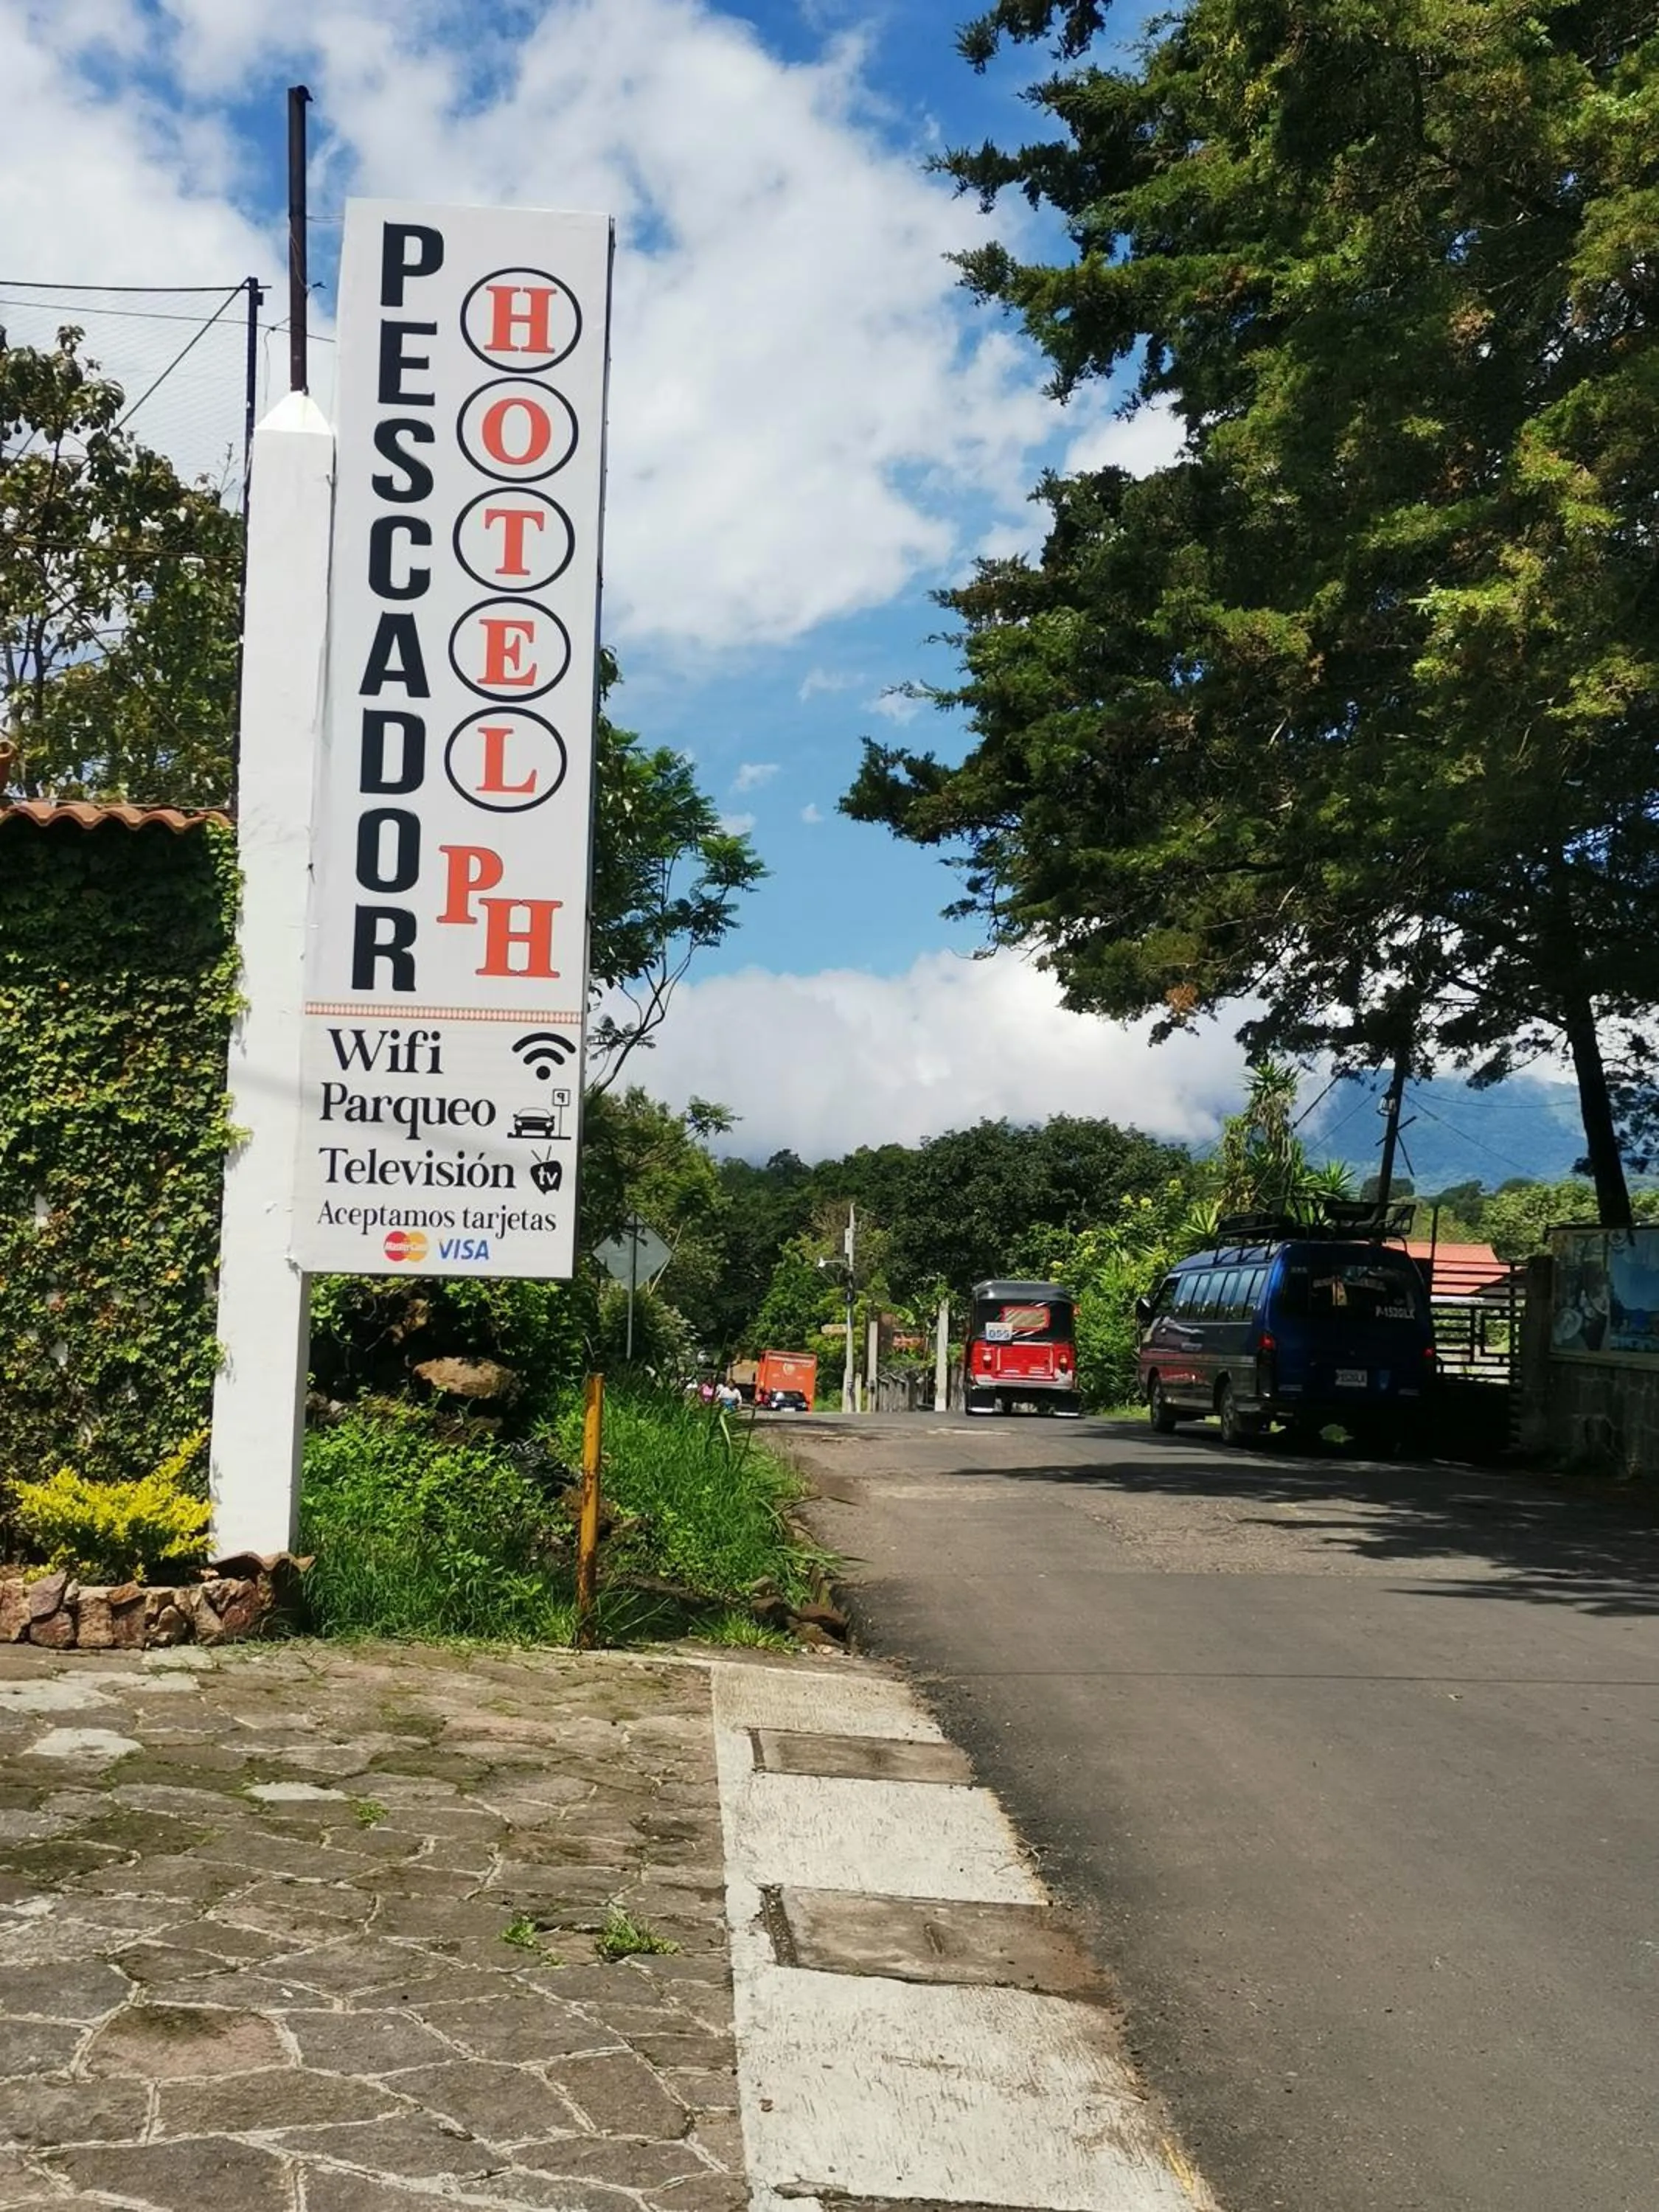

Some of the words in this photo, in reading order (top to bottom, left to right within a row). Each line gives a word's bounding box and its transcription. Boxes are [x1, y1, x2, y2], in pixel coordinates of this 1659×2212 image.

[475, 285, 558, 793] HOTEL
[351, 220, 445, 992] PESCADOR
[436, 844, 564, 978] PH
[327, 1029, 444, 1074] Wifi
[319, 1082, 496, 1141] Parqueo
[318, 1147, 517, 1189] Televisión
[318, 1200, 455, 1236] Aceptamos
[462, 1205, 557, 1239] tarjetas
[439, 1239, 490, 1260] VISA
